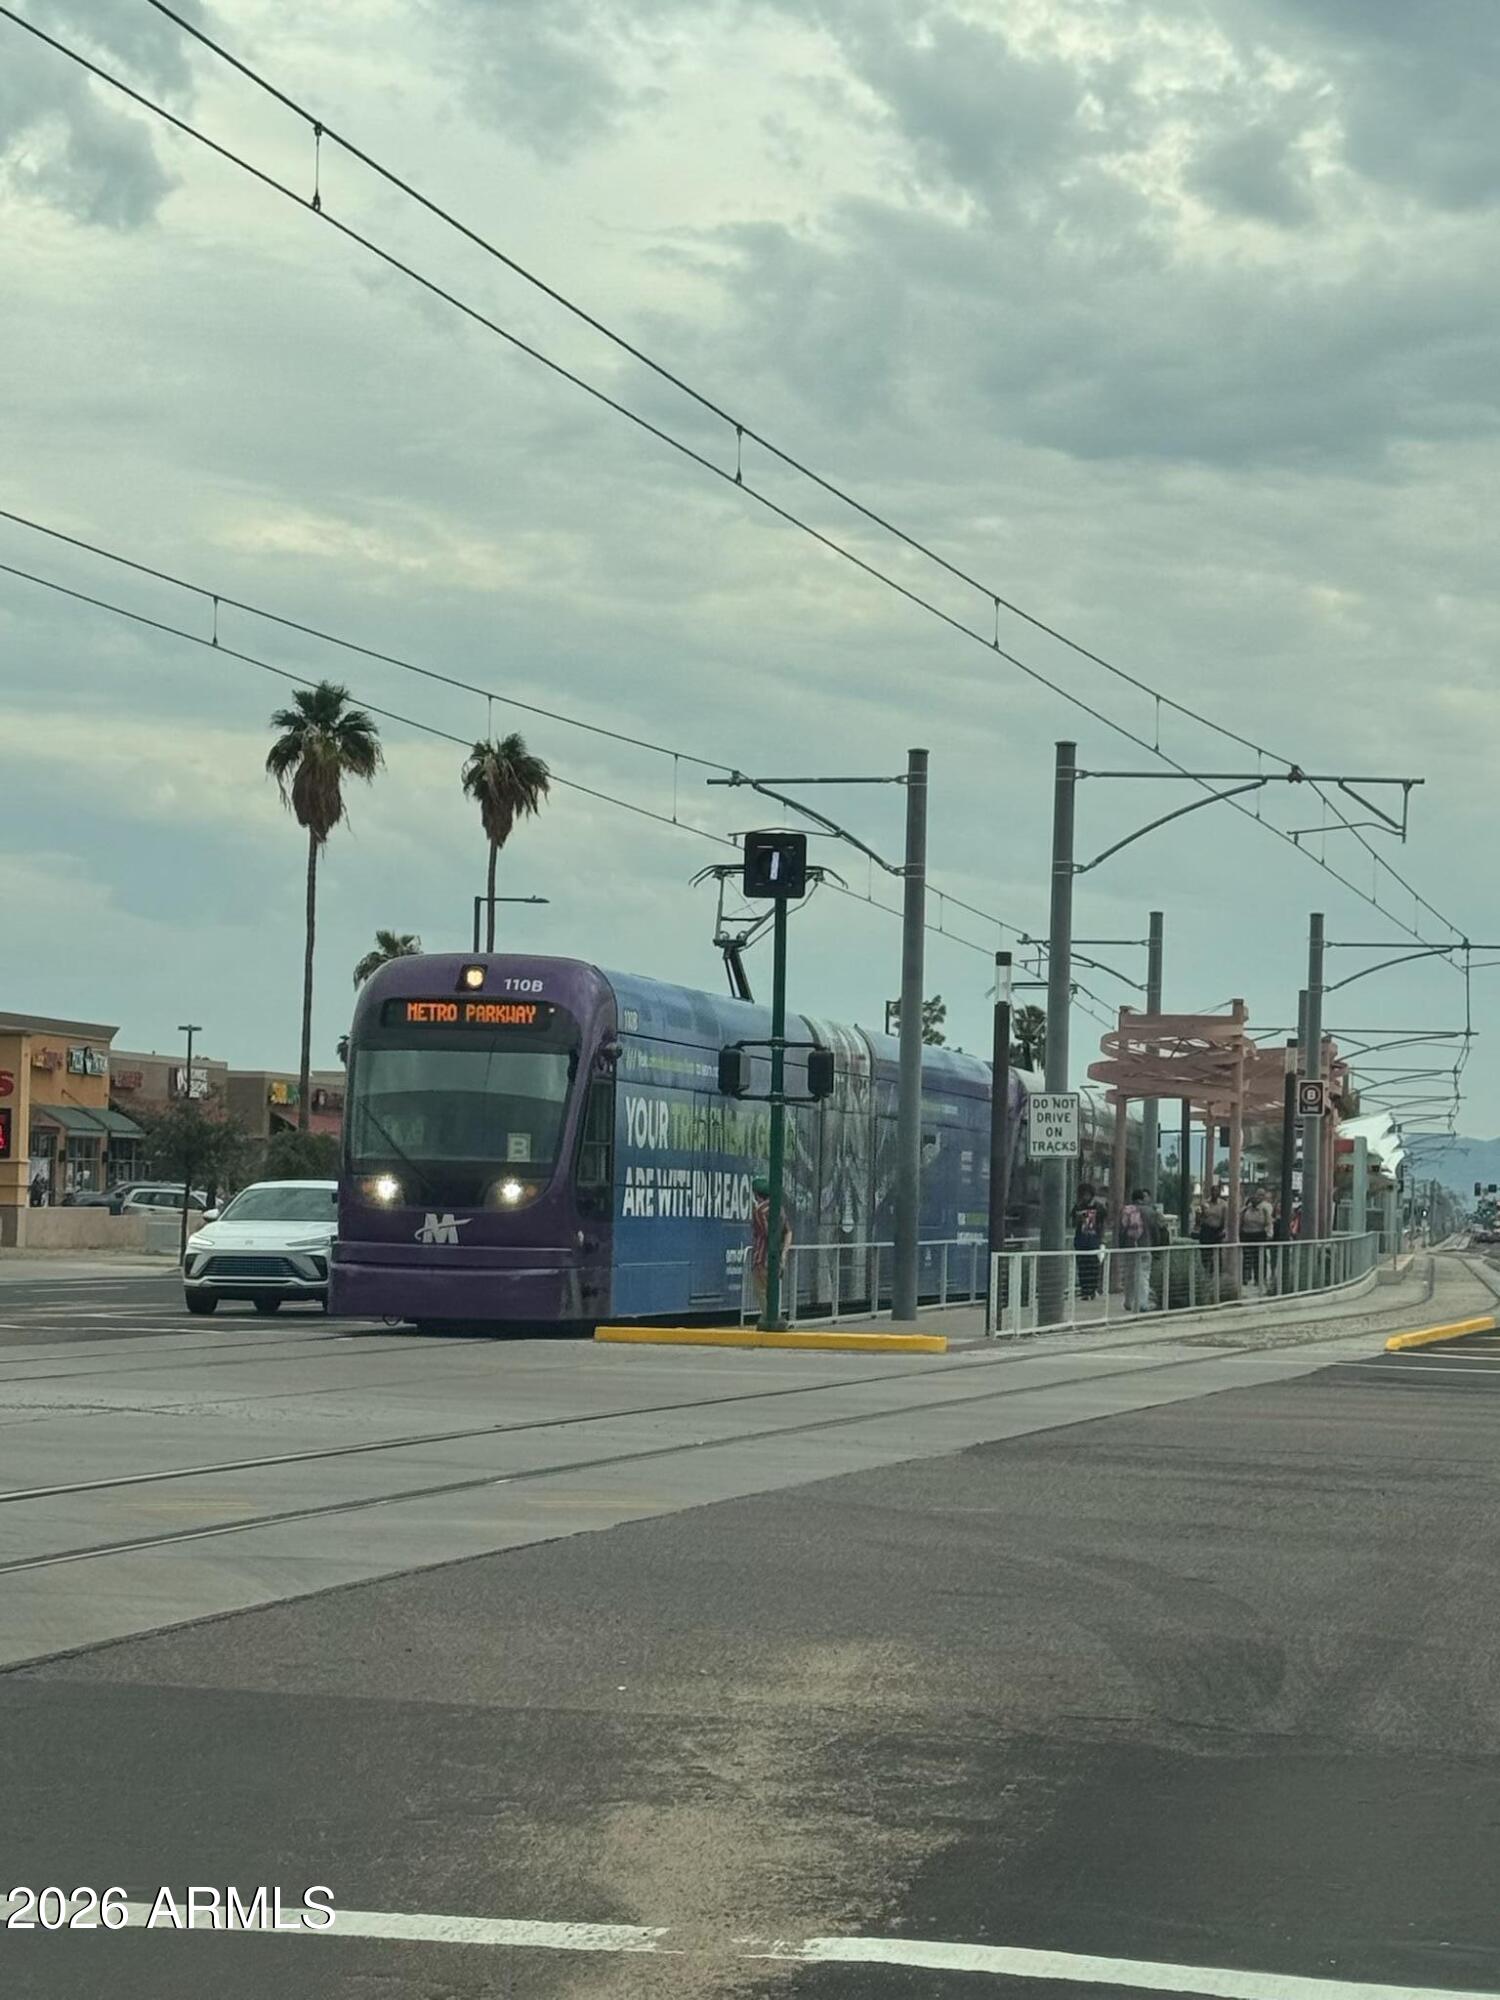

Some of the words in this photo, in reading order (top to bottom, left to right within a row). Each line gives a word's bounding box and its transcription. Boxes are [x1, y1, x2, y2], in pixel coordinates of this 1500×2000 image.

[504, 979, 544, 992] 110B
[407, 1003, 457, 1022] METRO
[466, 1004, 537, 1024] PARKWAY
[1033, 1099, 1048, 1109] DO
[1053, 1097, 1077, 1109] NOT
[625, 1096, 669, 1149] YOUR
[1037, 1112, 1071, 1123] DRIVE
[1046, 1127, 1062, 1137] ON
[1032, 1141, 1077, 1153] TRACKS
[622, 1167, 654, 1217] ARE
